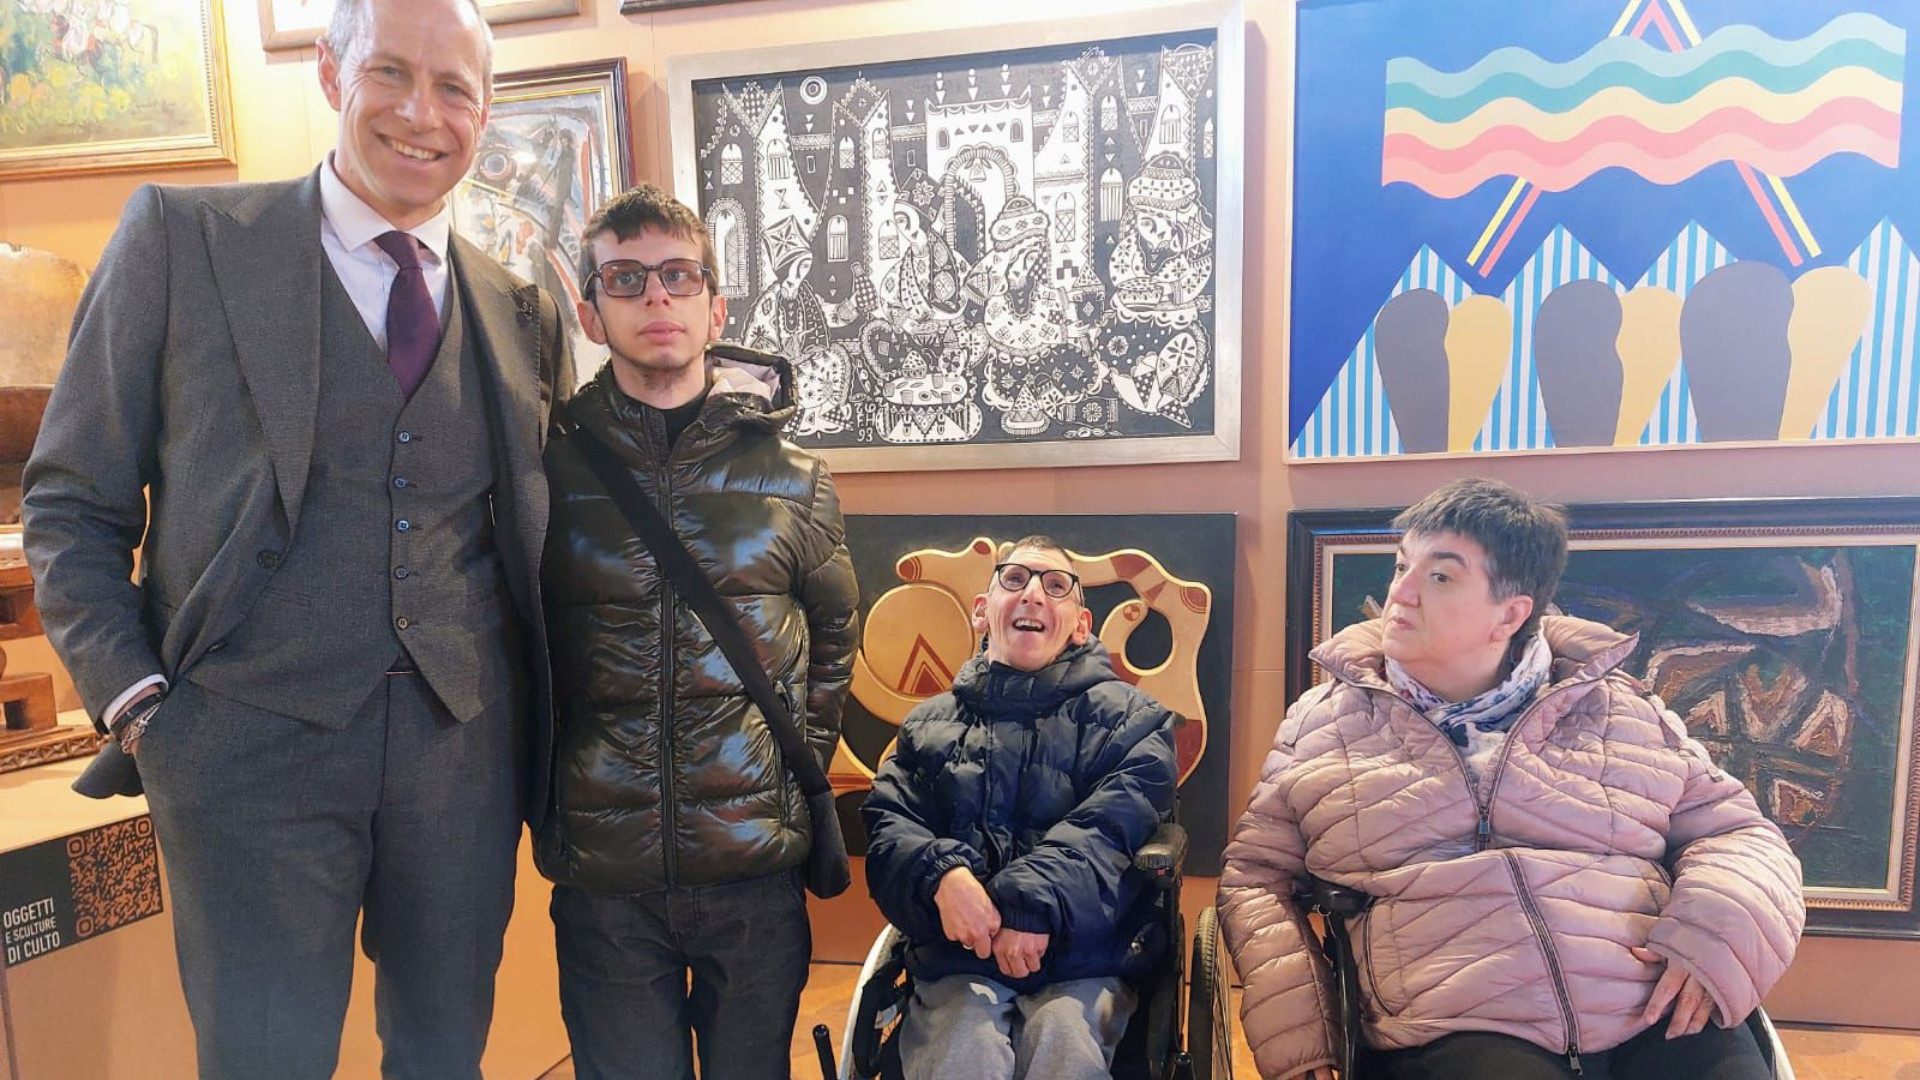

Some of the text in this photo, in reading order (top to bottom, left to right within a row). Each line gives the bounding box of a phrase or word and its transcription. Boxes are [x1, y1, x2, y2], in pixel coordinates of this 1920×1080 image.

[857, 427, 873, 442] 93
[3, 897, 54, 929] OGGETTI
[5, 916, 56, 944] E SCULTURE
[7, 931, 60, 964] DI CULTO
